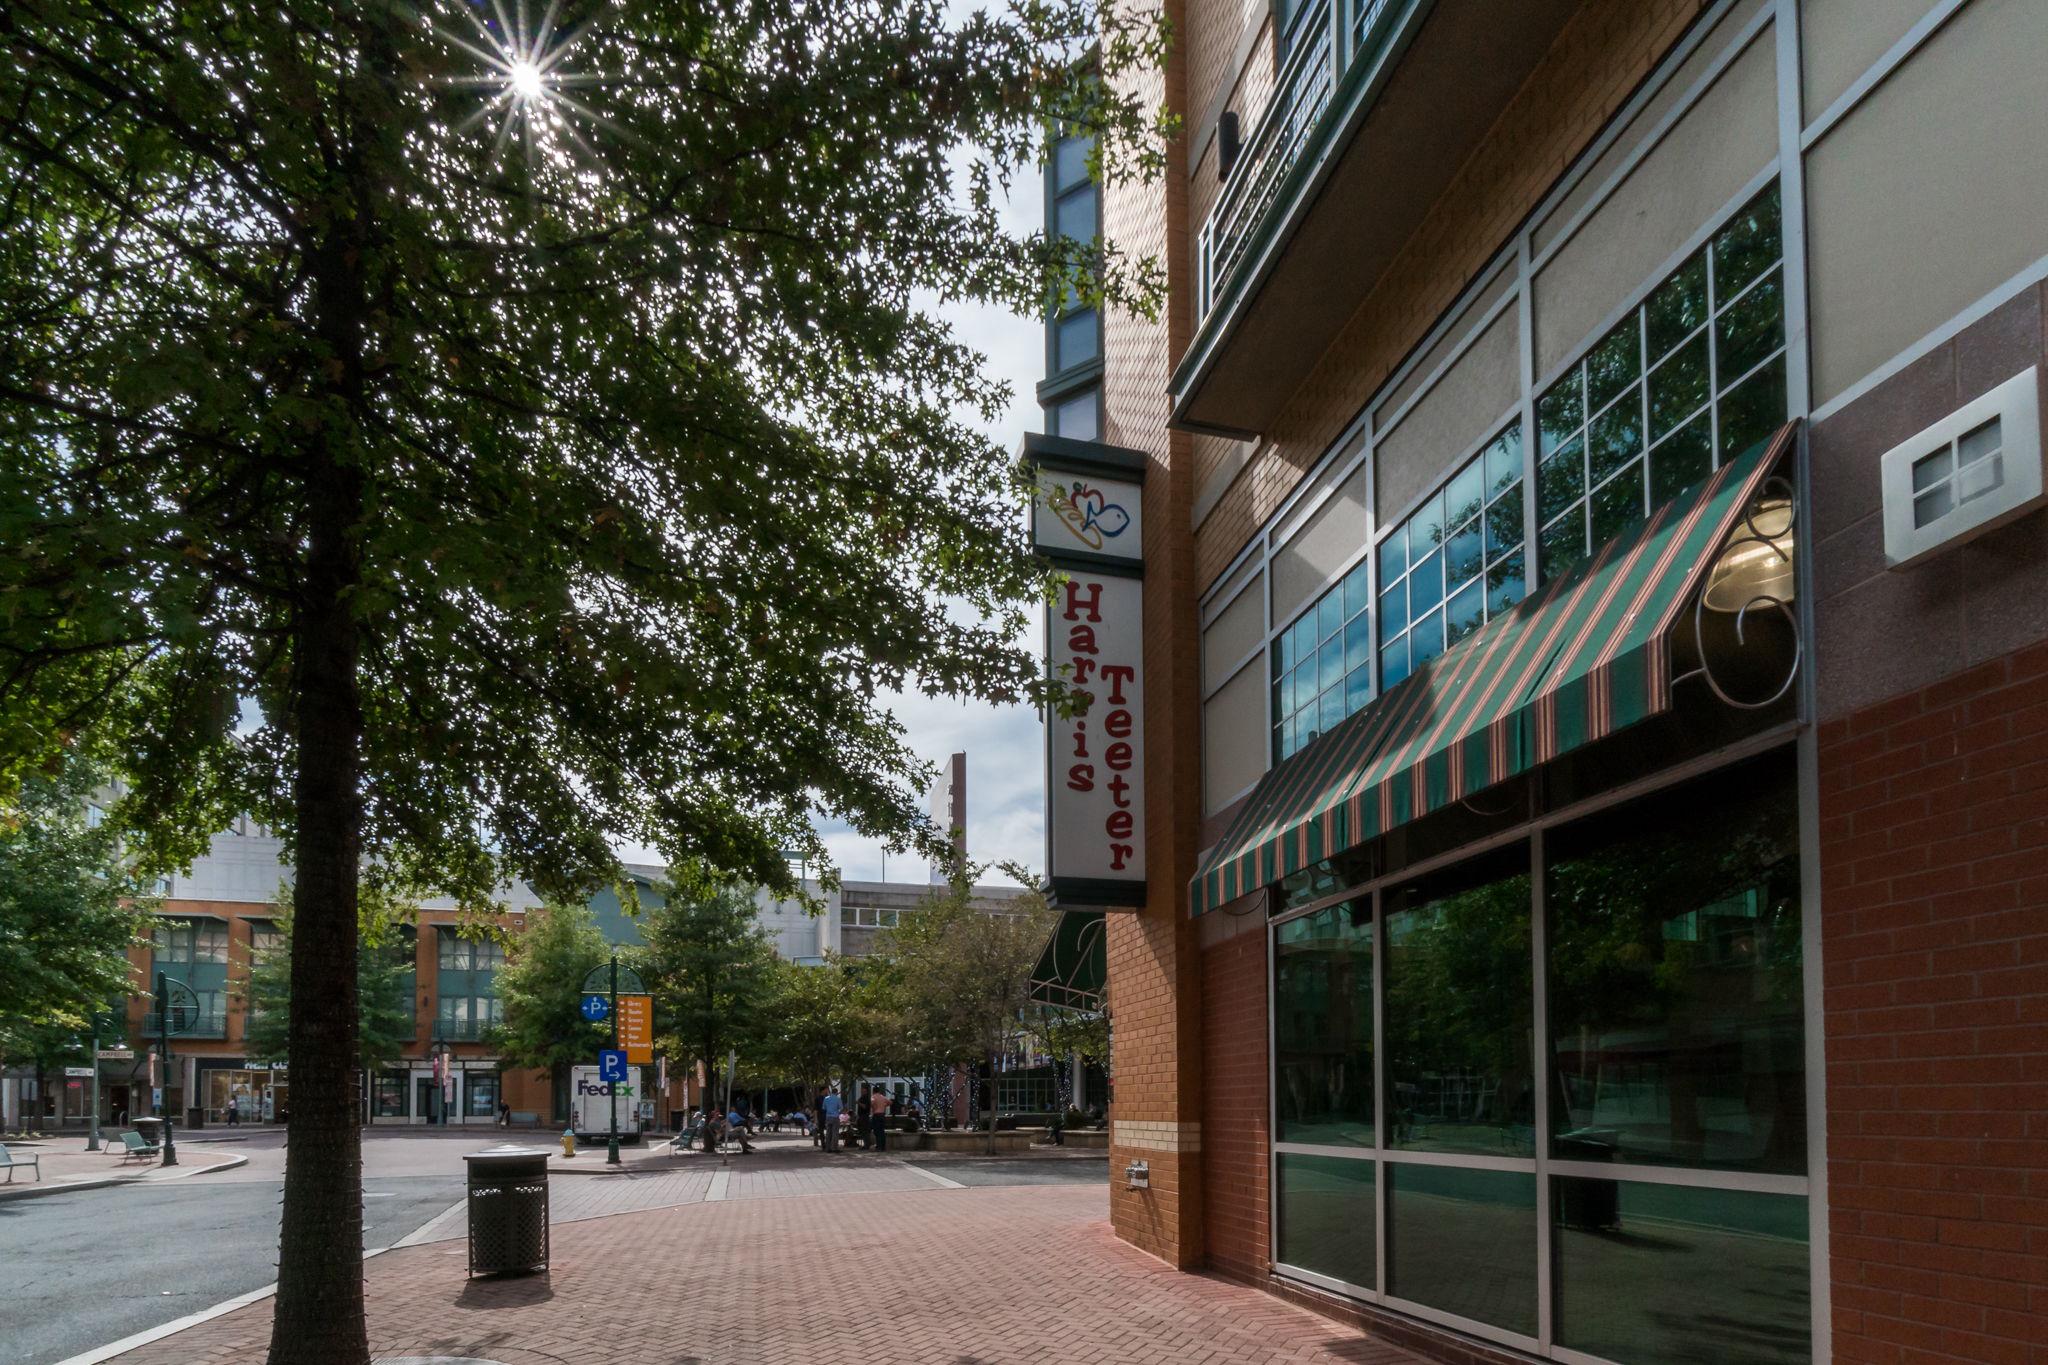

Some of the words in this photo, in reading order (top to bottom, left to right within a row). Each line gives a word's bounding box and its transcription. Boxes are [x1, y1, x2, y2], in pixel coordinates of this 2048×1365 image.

[1101, 665, 1134, 870] Teeter
[591, 1002, 601, 1014] P
[606, 1055, 618, 1073] P
[578, 1080, 635, 1097] FedEx
